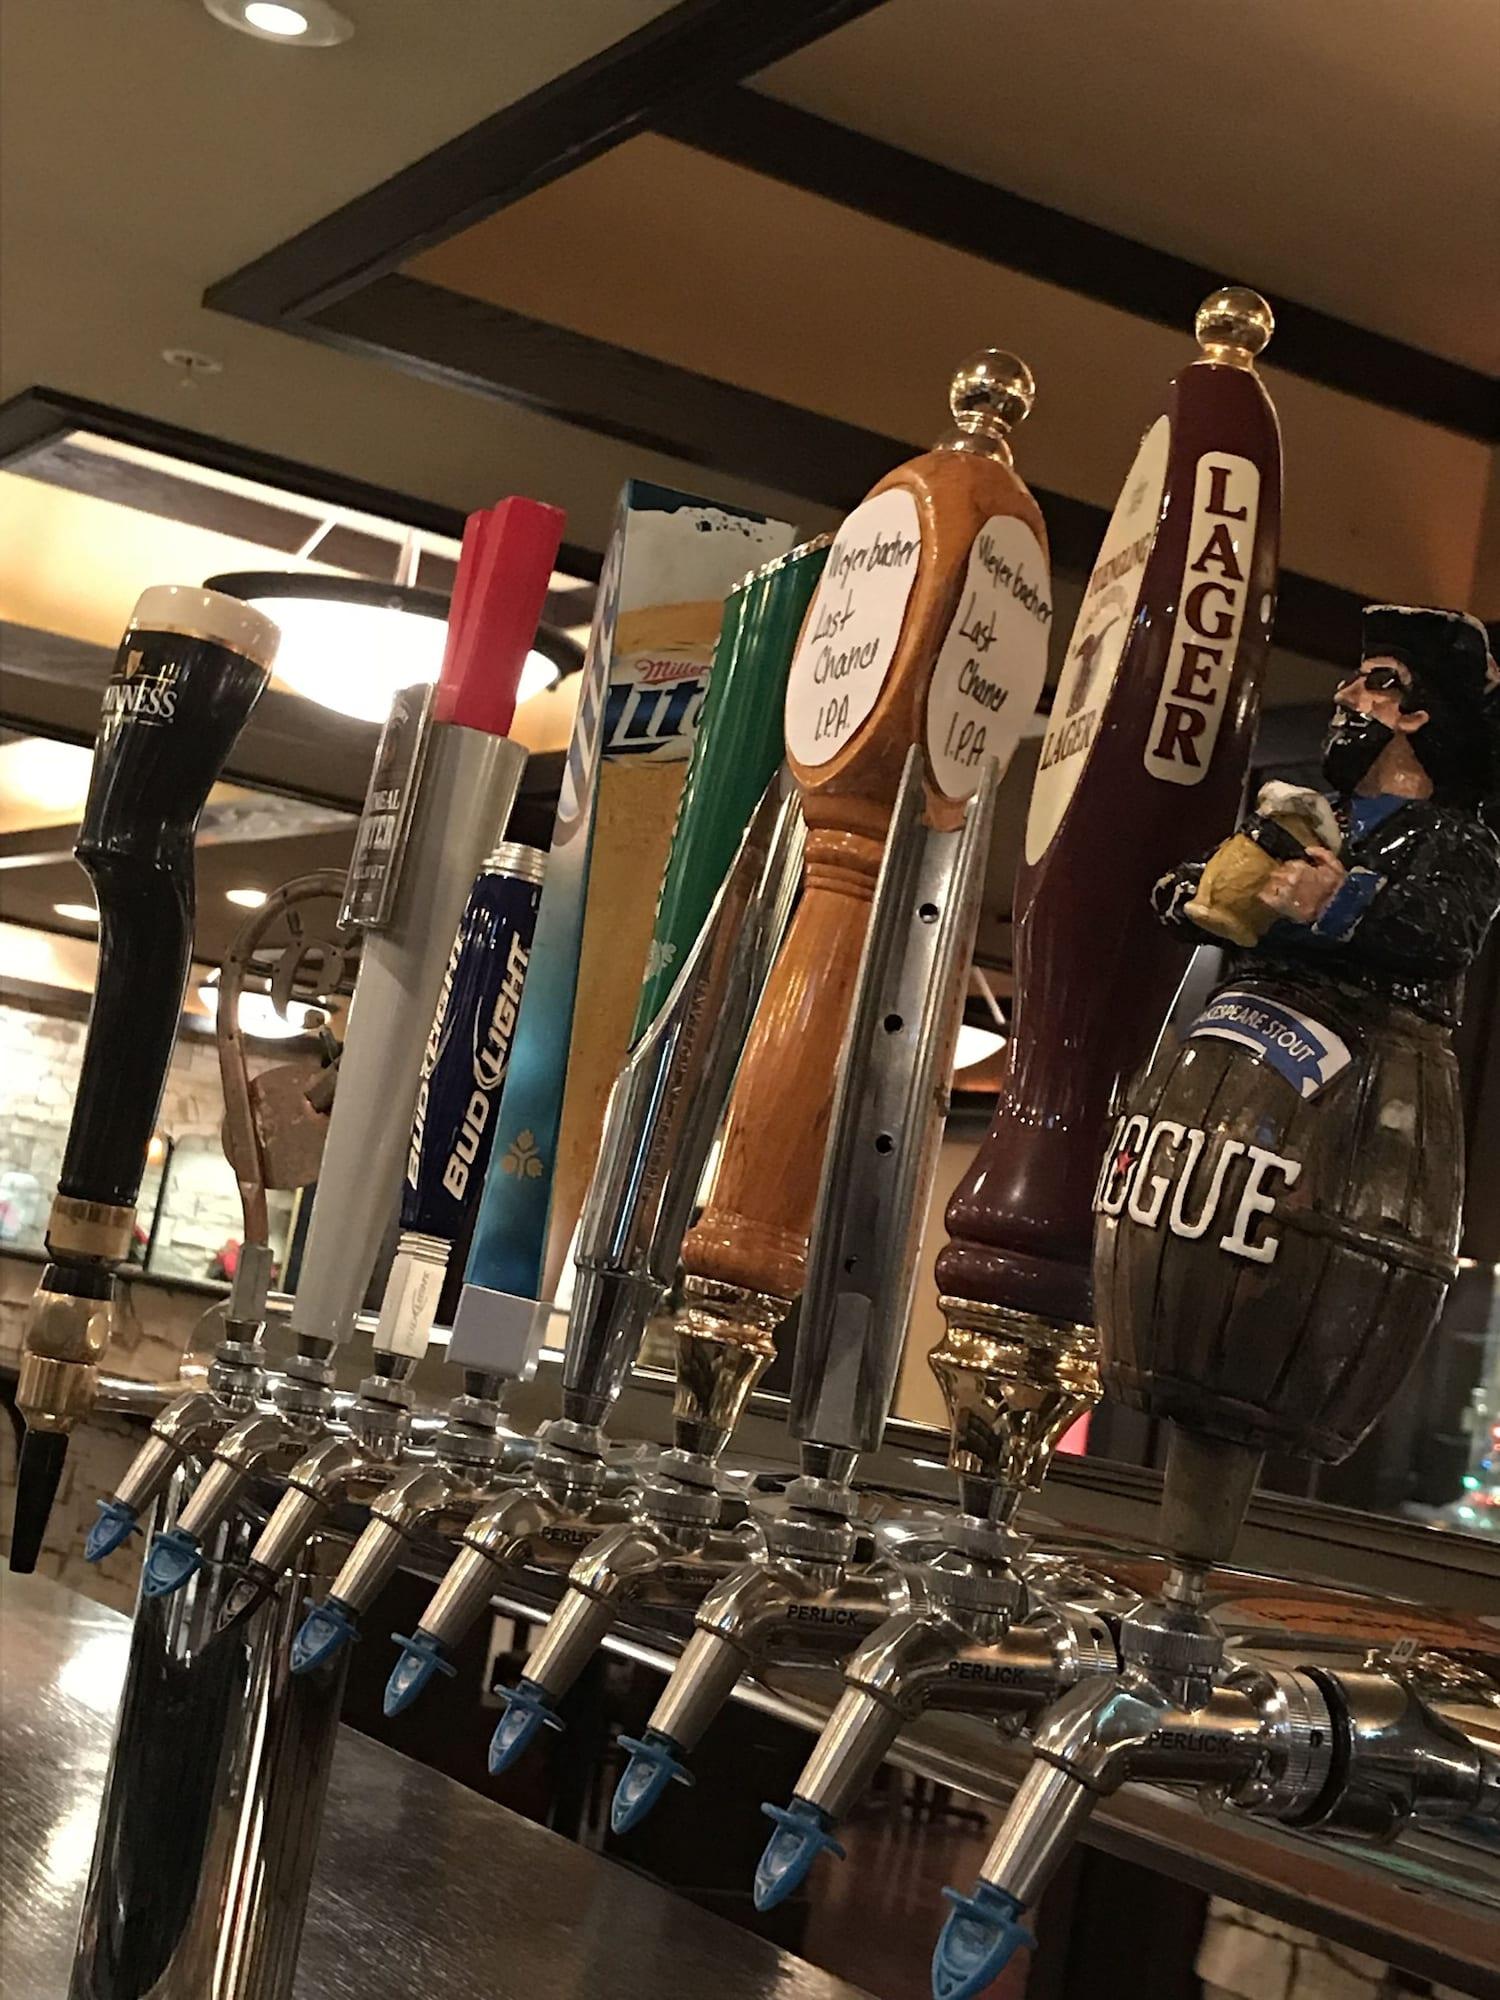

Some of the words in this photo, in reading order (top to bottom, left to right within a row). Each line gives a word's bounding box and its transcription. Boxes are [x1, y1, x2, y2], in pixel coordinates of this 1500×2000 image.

[1153, 466, 1247, 767] LAGER
[634, 659, 712, 685] Miller
[1040, 709, 1097, 771] LAGER
[1262, 1020, 1316, 1063] STOUT
[443, 1090, 490, 1201] BUD
[480, 930, 530, 1077] LIGHT
[397, 1077, 430, 1191] BUD
[787, 1604, 858, 1626] PERLICK
[948, 1661, 1024, 1684] PERLICK
[1148, 1730, 1232, 1754] PERLICK
